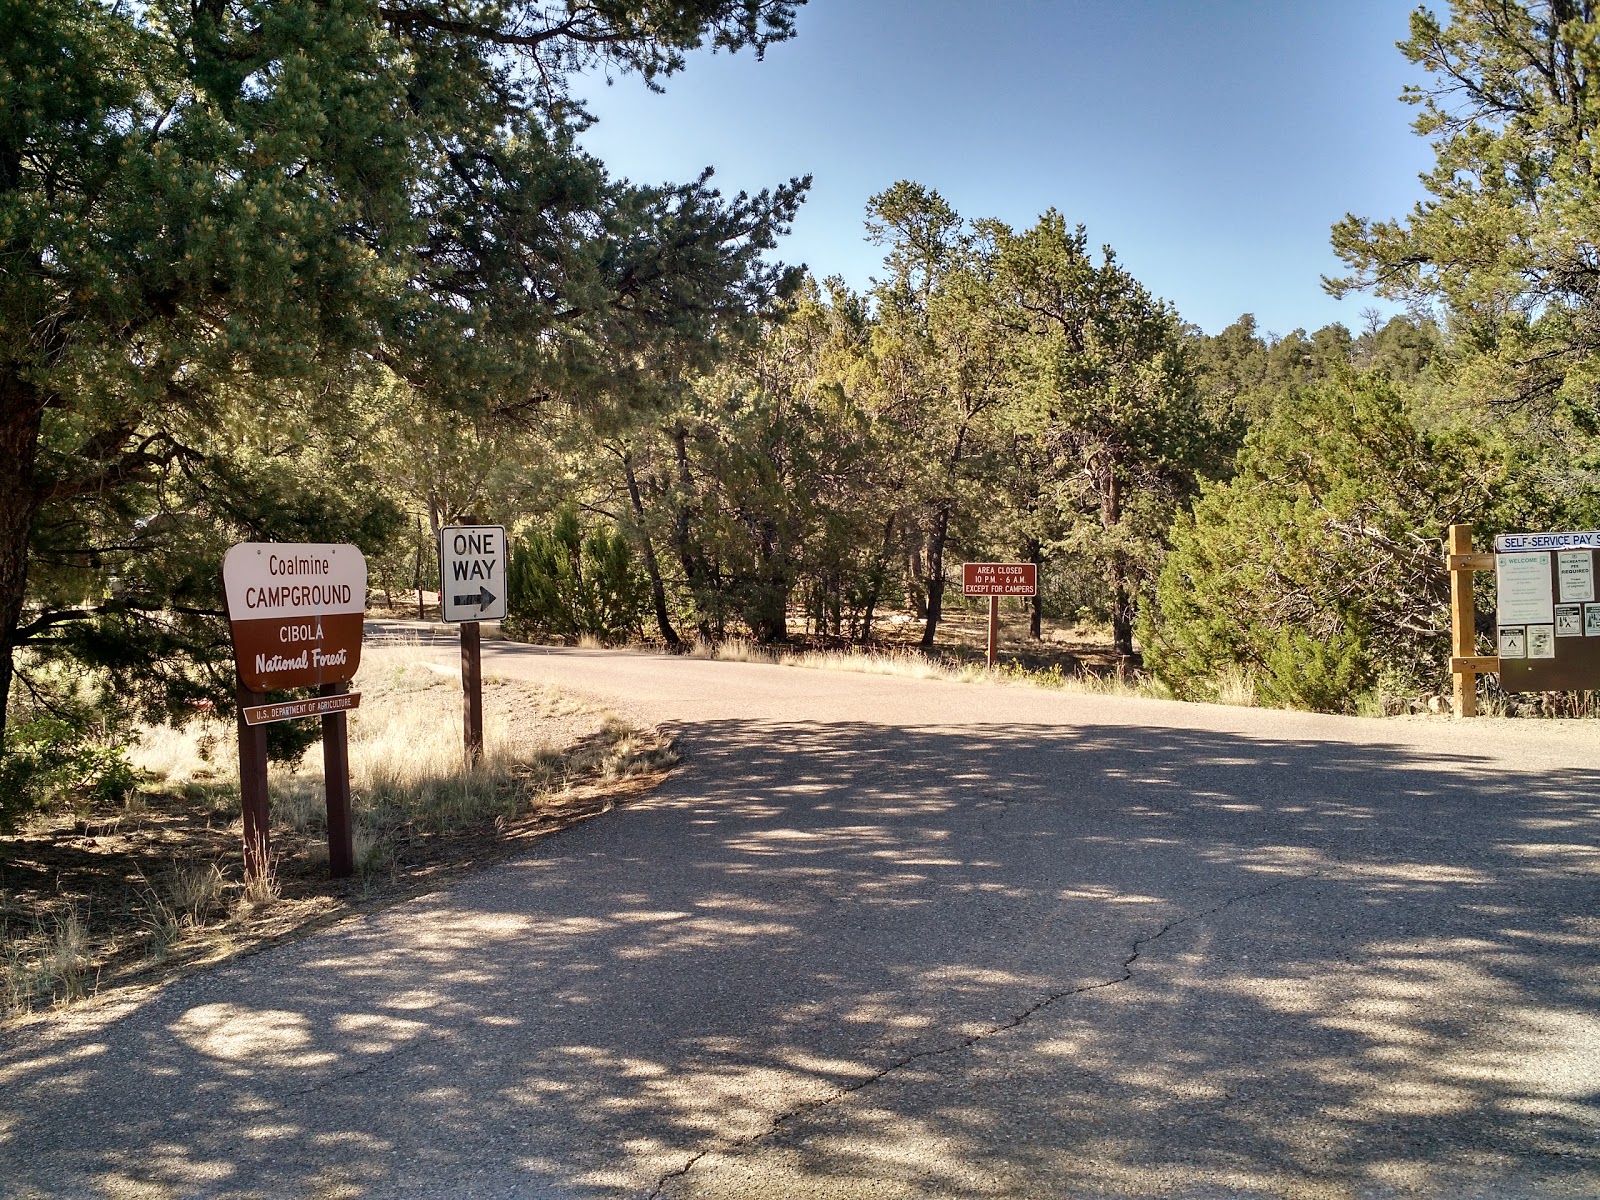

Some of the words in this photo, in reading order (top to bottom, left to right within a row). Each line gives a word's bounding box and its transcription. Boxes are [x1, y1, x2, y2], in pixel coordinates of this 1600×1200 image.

[453, 534, 495, 556] ONE
[1504, 536, 1571, 548] SELF-SERVICE
[1573, 534, 1593, 545] PAY
[269, 554, 329, 576] Coalmine
[452, 559, 496, 581] WAY
[977, 566, 995, 574] AREA
[997, 566, 1023, 575] CLOSED
[965, 584, 989, 593] EXCEPT
[991, 585, 1003, 593] FOR
[1004, 585, 1034, 593] CAMPERS
[975, 575, 982, 583] 10
[1005, 575, 1011, 583] 6
[1013, 575, 1027, 584] A.M.
[246, 584, 351, 609] CAMPGROUND
[279, 624, 324, 643] CIBOLA
[255, 649, 309, 675] National
[311, 648, 347, 668] Forest
[256, 710, 270, 720] U.S.
[271, 704, 307, 718] DEPARTMENT
[308, 703, 316, 712] OF
[317, 697, 352, 711] AGRICULTURE
